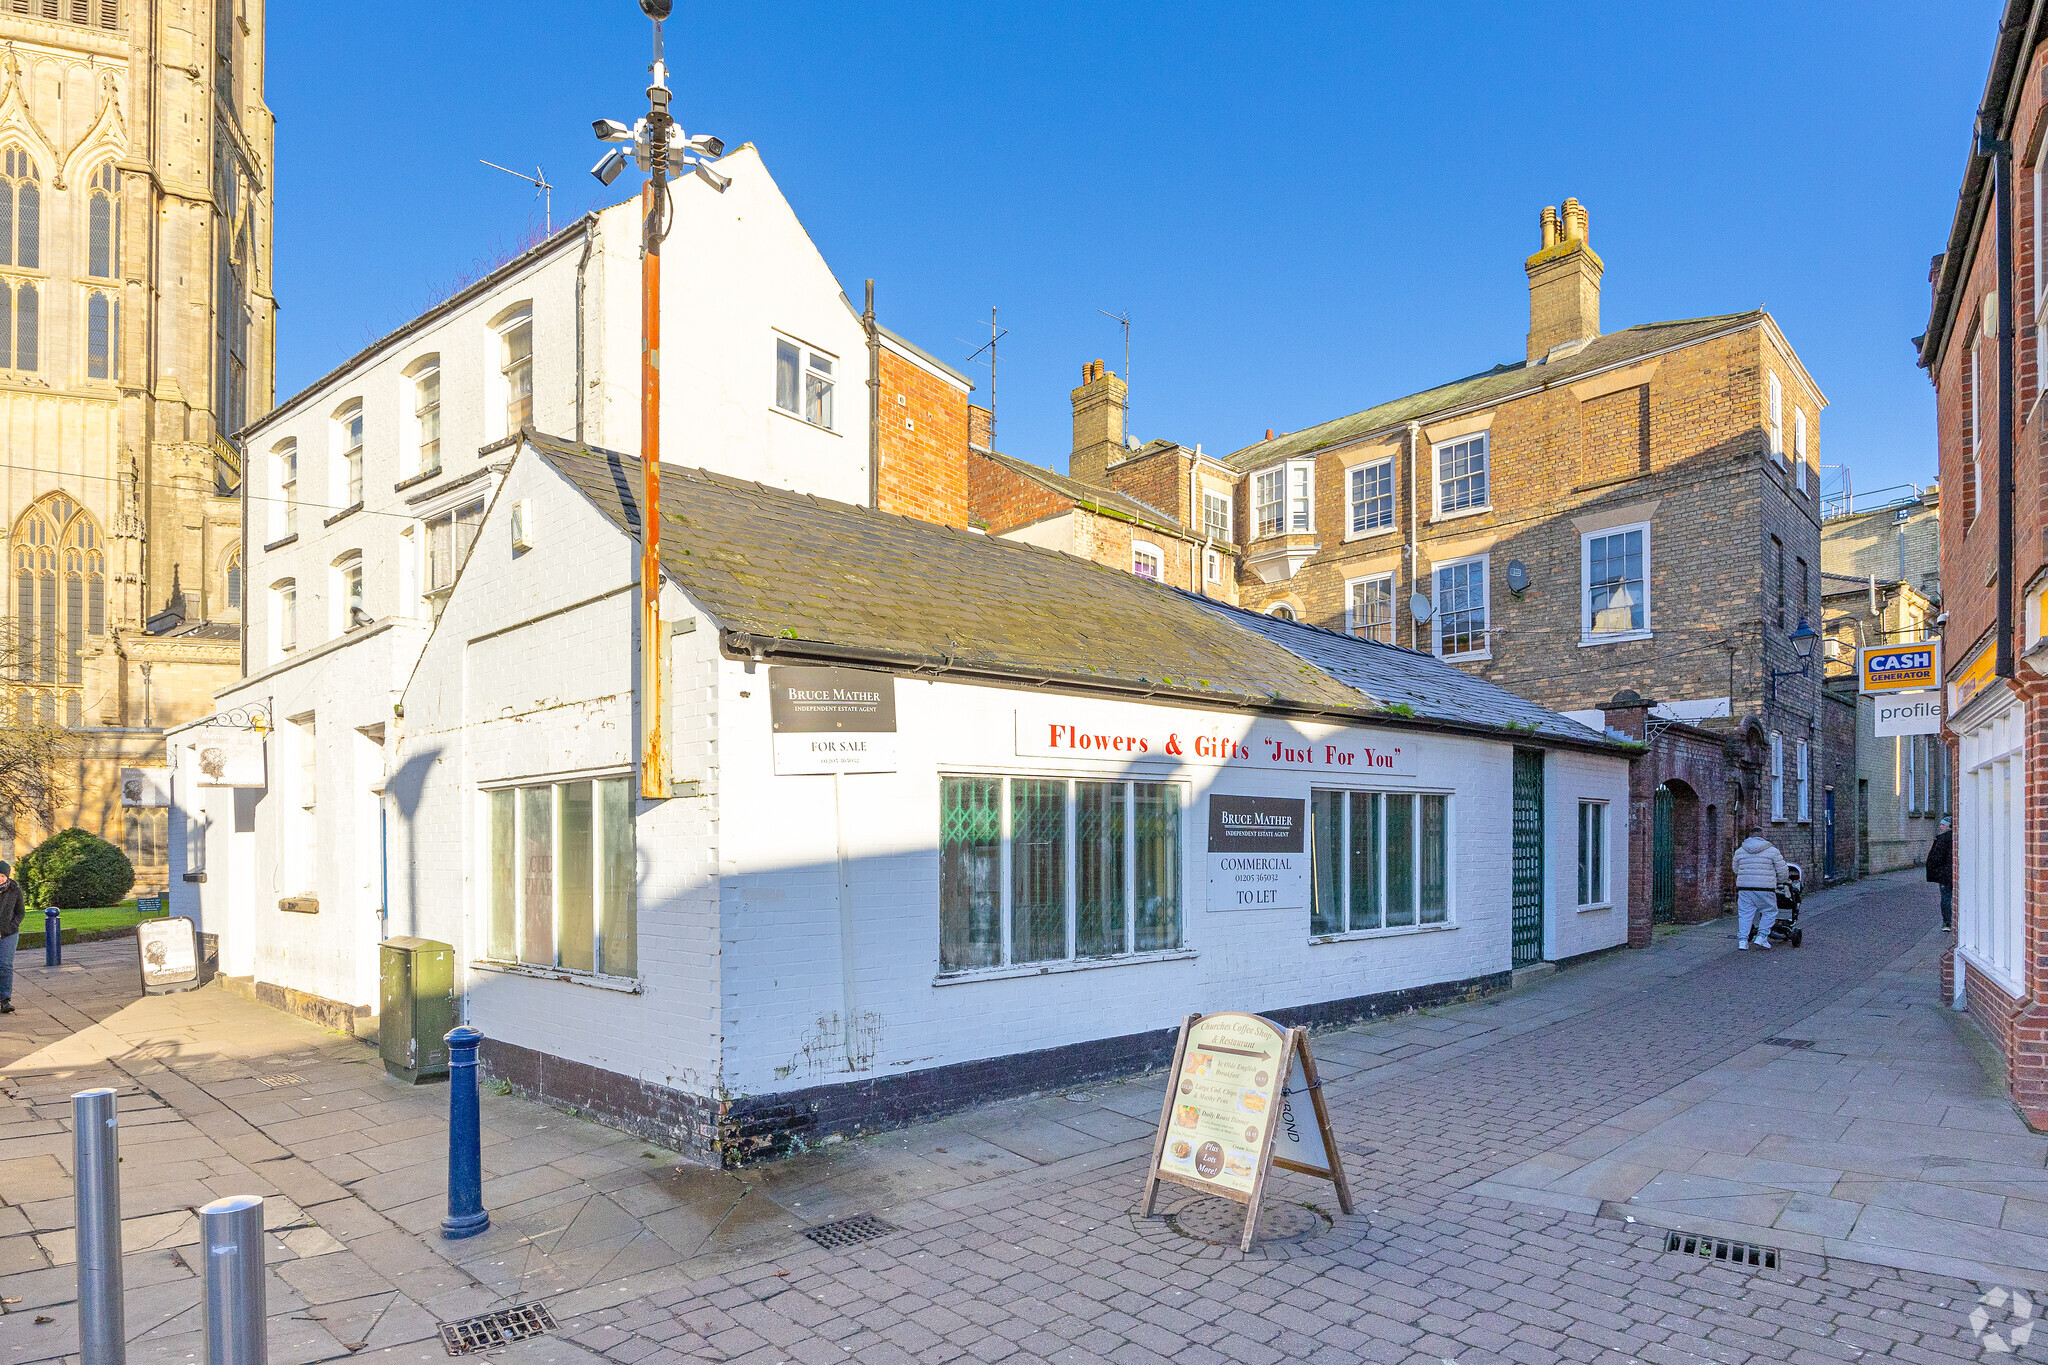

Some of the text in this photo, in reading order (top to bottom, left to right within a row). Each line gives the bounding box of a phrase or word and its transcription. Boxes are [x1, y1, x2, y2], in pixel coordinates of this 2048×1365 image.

[1870, 652, 1929, 671] CASH
[1870, 670, 1930, 682] GENERATOR
[811, 741, 867, 752] FOR SALE
[1047, 723, 1148, 753] Flowers
[1165, 733, 1183, 756] &
[1194, 735, 1250, 760] Gifts
[1325, 745, 1355, 766] For
[1220, 857, 1292, 871] COMMERCIAL
[1235, 874, 1279, 883] 01205 365032
[1236, 890, 1278, 904] TO LET
[152, 966, 195, 976] Collectables
[1200, 1022, 1273, 1040] Churches Coffee Shop
[1211, 1035, 1256, 1049] & Restaurant
[1237, 1063, 1257, 1073] English
[1215, 1070, 1240, 1079] Breakfast
[1195, 1083, 1210, 1092] Large
[1222, 1088, 1237, 1097] Chips
[1199, 1093, 1216, 1102] Mushy
[1216, 1096, 1229, 1104] Peas
[1201, 1110, 1215, 1120] Daily
[1216, 1113, 1230, 1122] Roast
[1230, 1116, 1250, 1126] Dinner
[1205, 1143, 1219, 1153] Plus
[1202, 1154, 1217, 1163] Lots
[1197, 1164, 1218, 1175] More!
